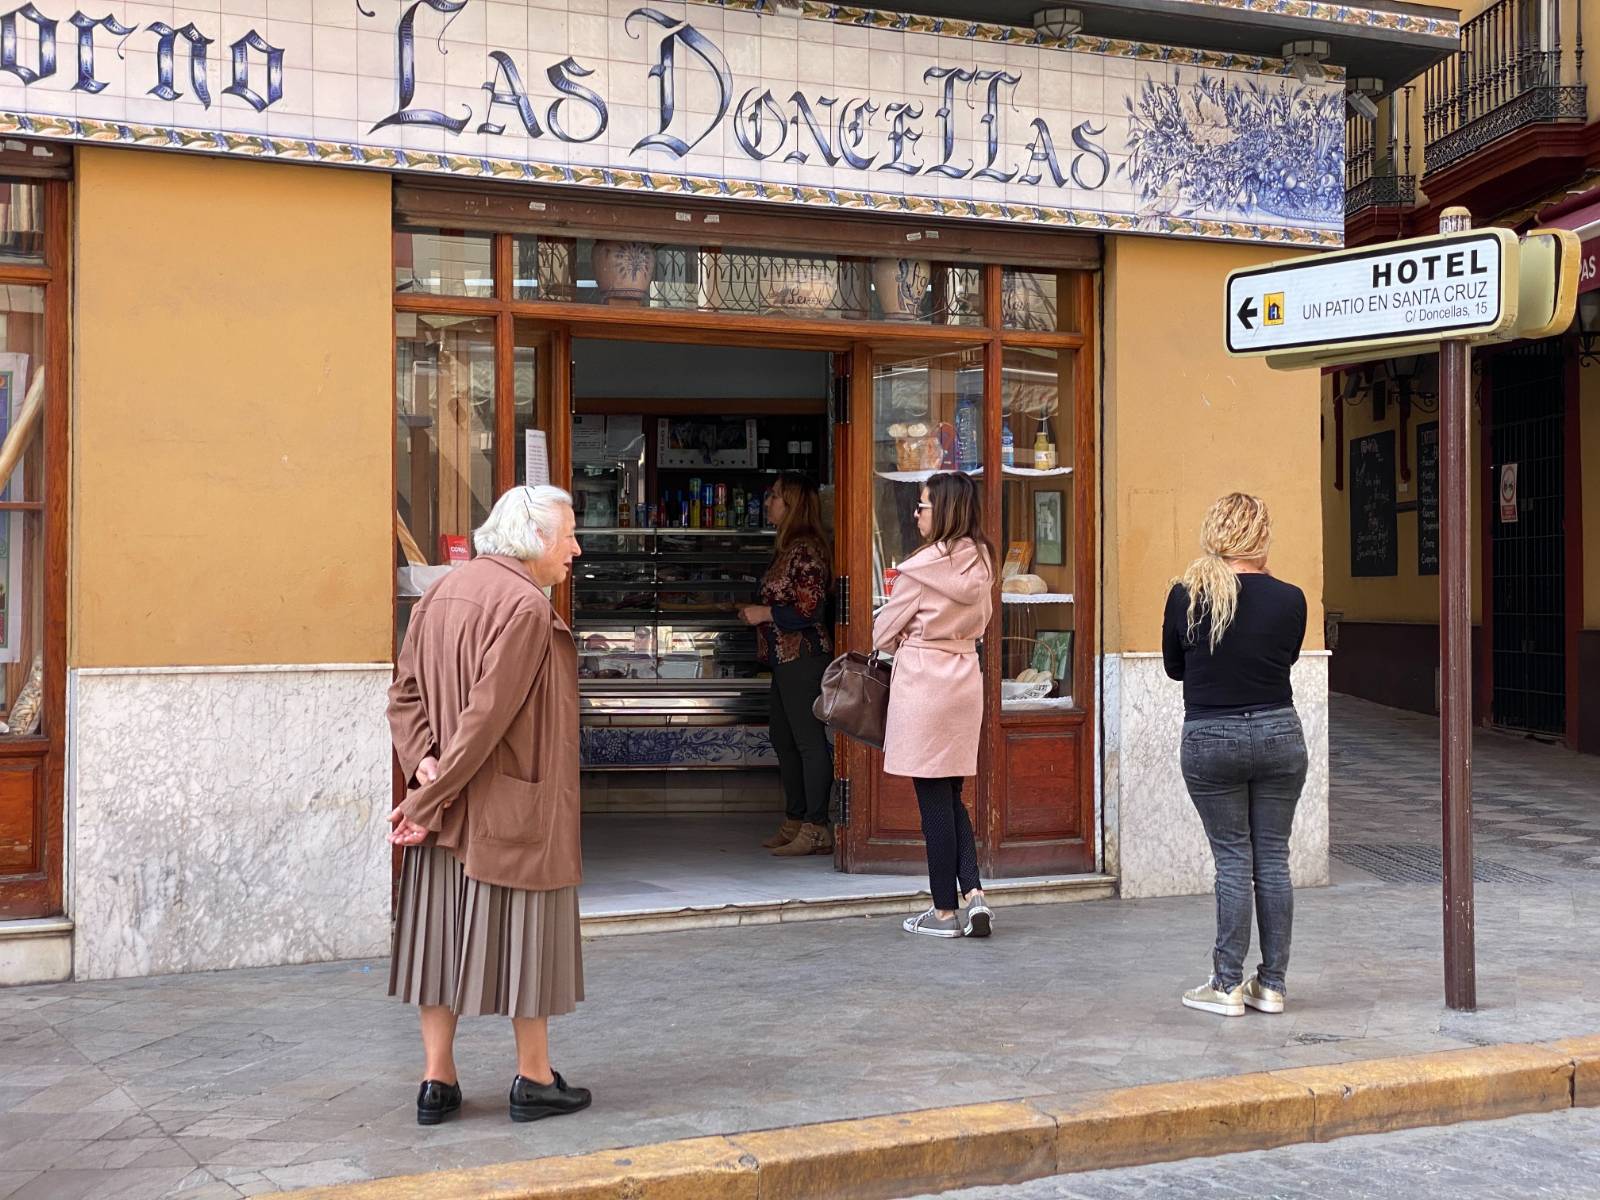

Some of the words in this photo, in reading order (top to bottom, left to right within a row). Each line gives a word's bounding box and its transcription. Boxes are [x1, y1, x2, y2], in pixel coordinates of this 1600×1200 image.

[1372, 249, 1488, 289] HOTEL
[1579, 255, 1597, 281] AS
[1303, 303, 1321, 320] UN
[1325, 297, 1365, 317] PATIO
[1369, 294, 1388, 312] EN
[1392, 288, 1441, 308] SANTA
[1444, 281, 1487, 303] CRUZ
[1405, 310, 1417, 323] C/
[1419, 305, 1471, 322] Doncellas,
[1475, 302, 1488, 315] 15
